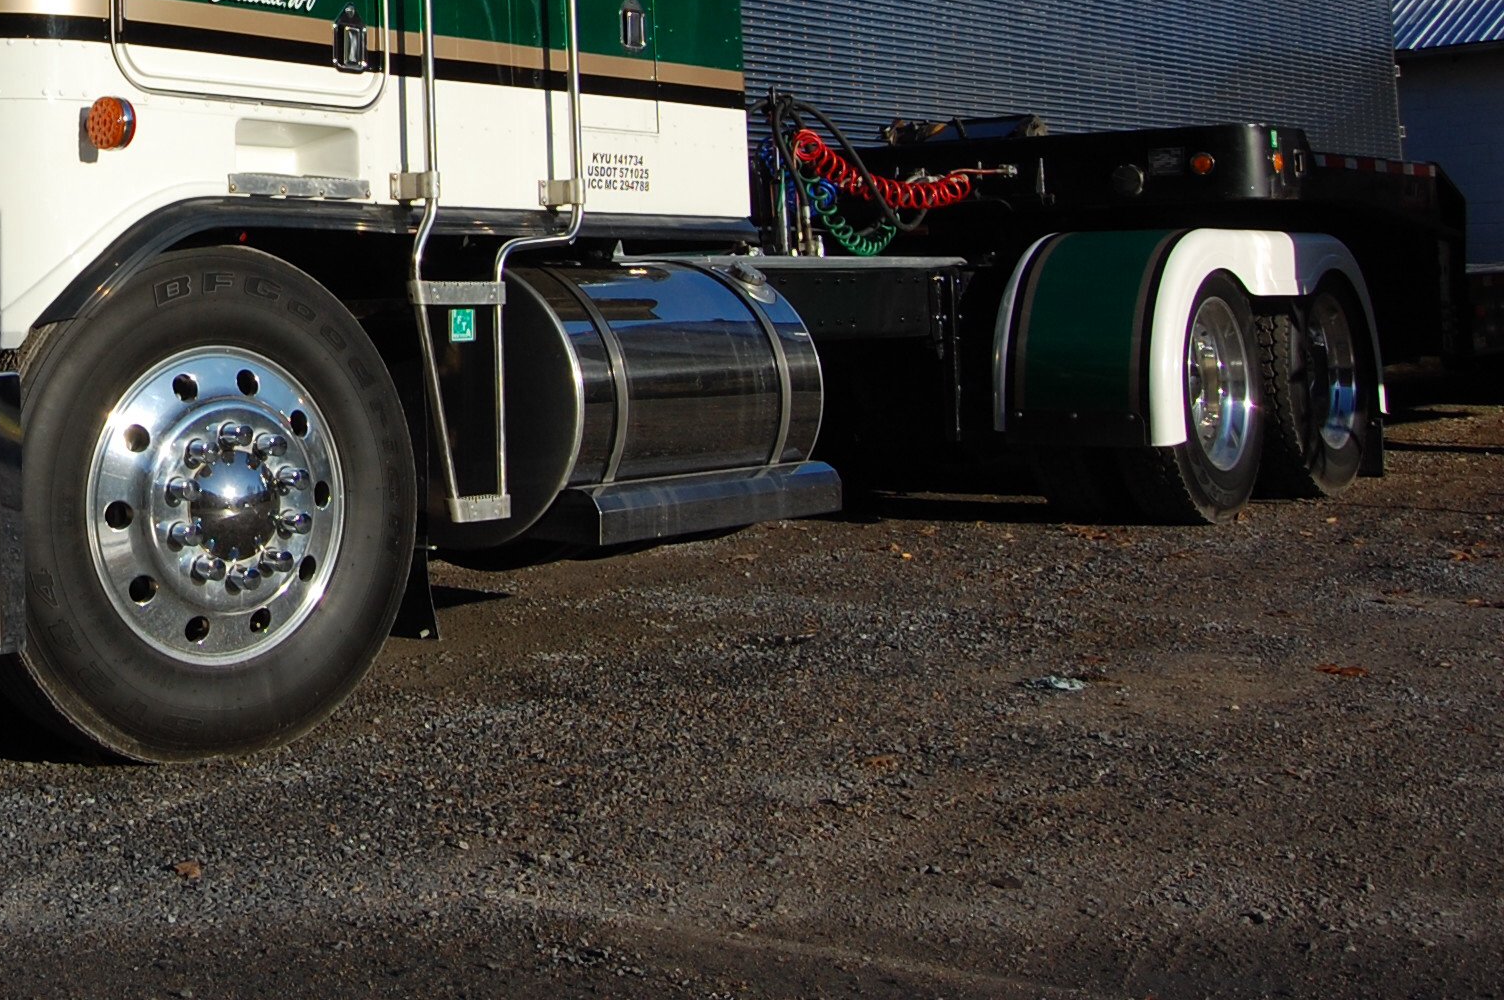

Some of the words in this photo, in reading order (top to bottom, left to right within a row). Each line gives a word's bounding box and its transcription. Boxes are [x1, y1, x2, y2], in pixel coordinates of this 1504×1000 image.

[592, 153, 611, 164] KYU
[587, 166, 618, 178] USDOT
[619, 167, 649, 179] 571025
[587, 178, 603, 189] ICC
[605, 179, 618, 190] MC
